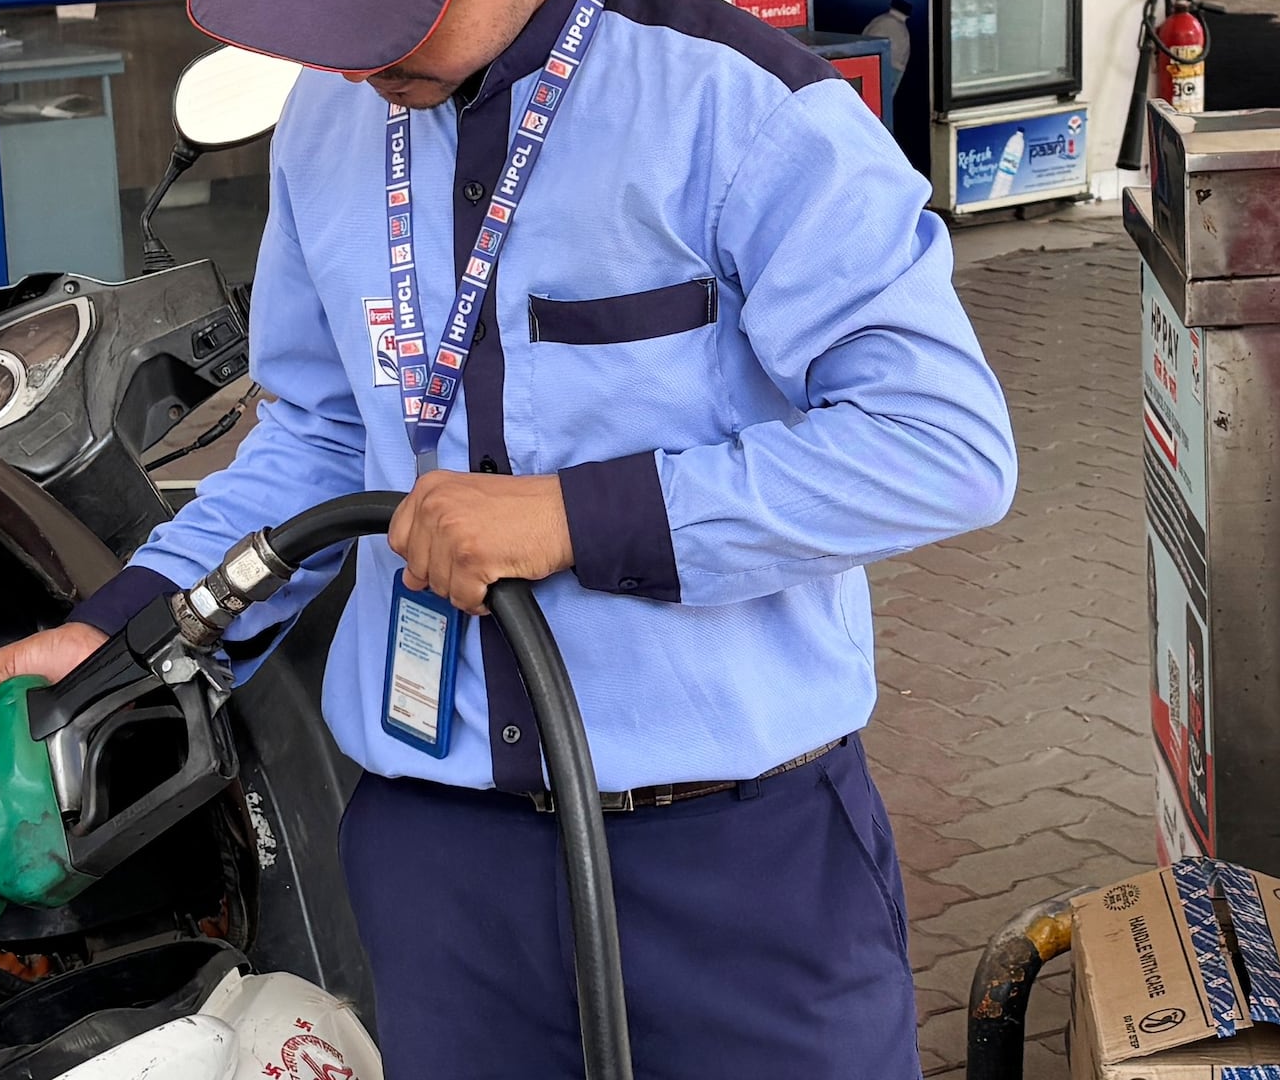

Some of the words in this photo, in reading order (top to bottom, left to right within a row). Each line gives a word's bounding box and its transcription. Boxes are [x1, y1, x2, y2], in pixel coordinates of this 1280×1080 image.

[561, 5, 595, 53] HPCL
[391, 125, 406, 179] HPCL
[500, 143, 532, 196] HPCL
[396, 274, 417, 329] HPCL
[448, 290, 477, 342] HPCL
[1150, 297, 1161, 343] HP
[1162, 310, 1179, 371] PAY
[1128, 915, 1153, 953] HANDLE
[1140, 950, 1159, 976] WITH
[1144, 975, 1165, 999] CARE
